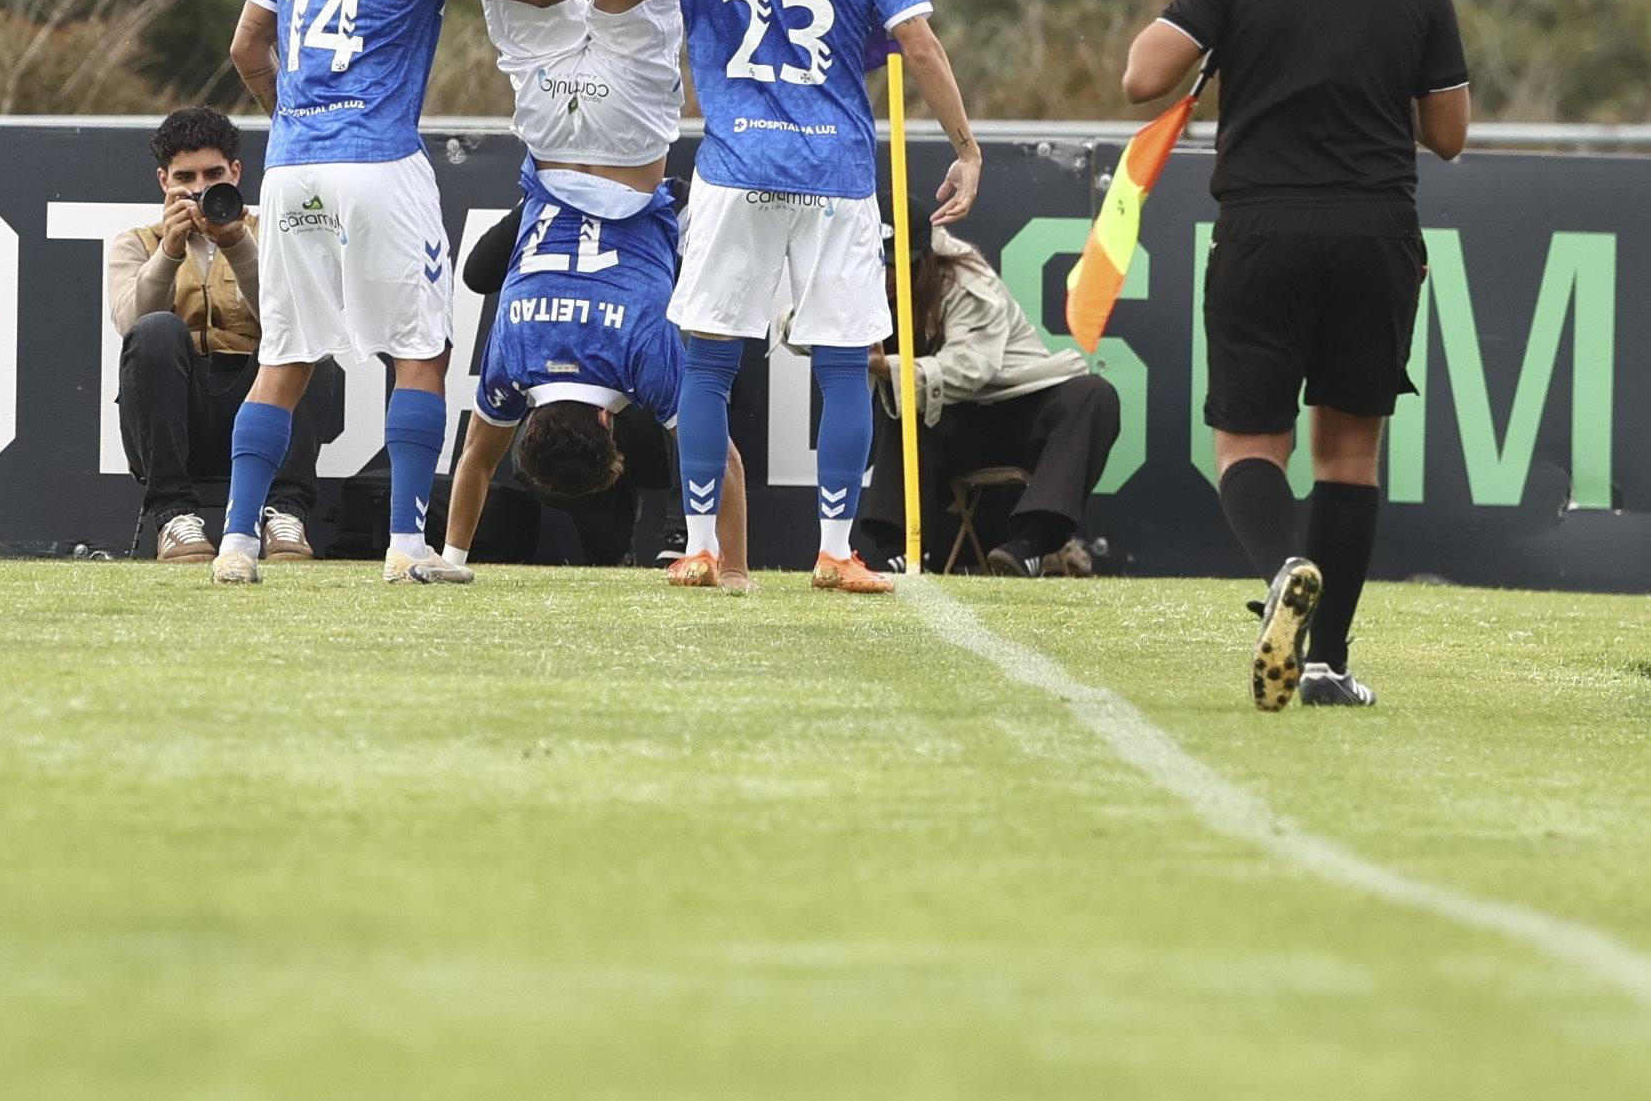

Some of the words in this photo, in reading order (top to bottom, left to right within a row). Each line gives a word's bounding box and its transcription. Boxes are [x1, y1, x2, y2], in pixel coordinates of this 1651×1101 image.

[749, 119, 799, 132] HOSPITAL
[815, 124, 837, 135] LUZ
[519, 202, 619, 275] 17
[509, 297, 590, 324] LEITAO
[598, 301, 625, 329] H.
